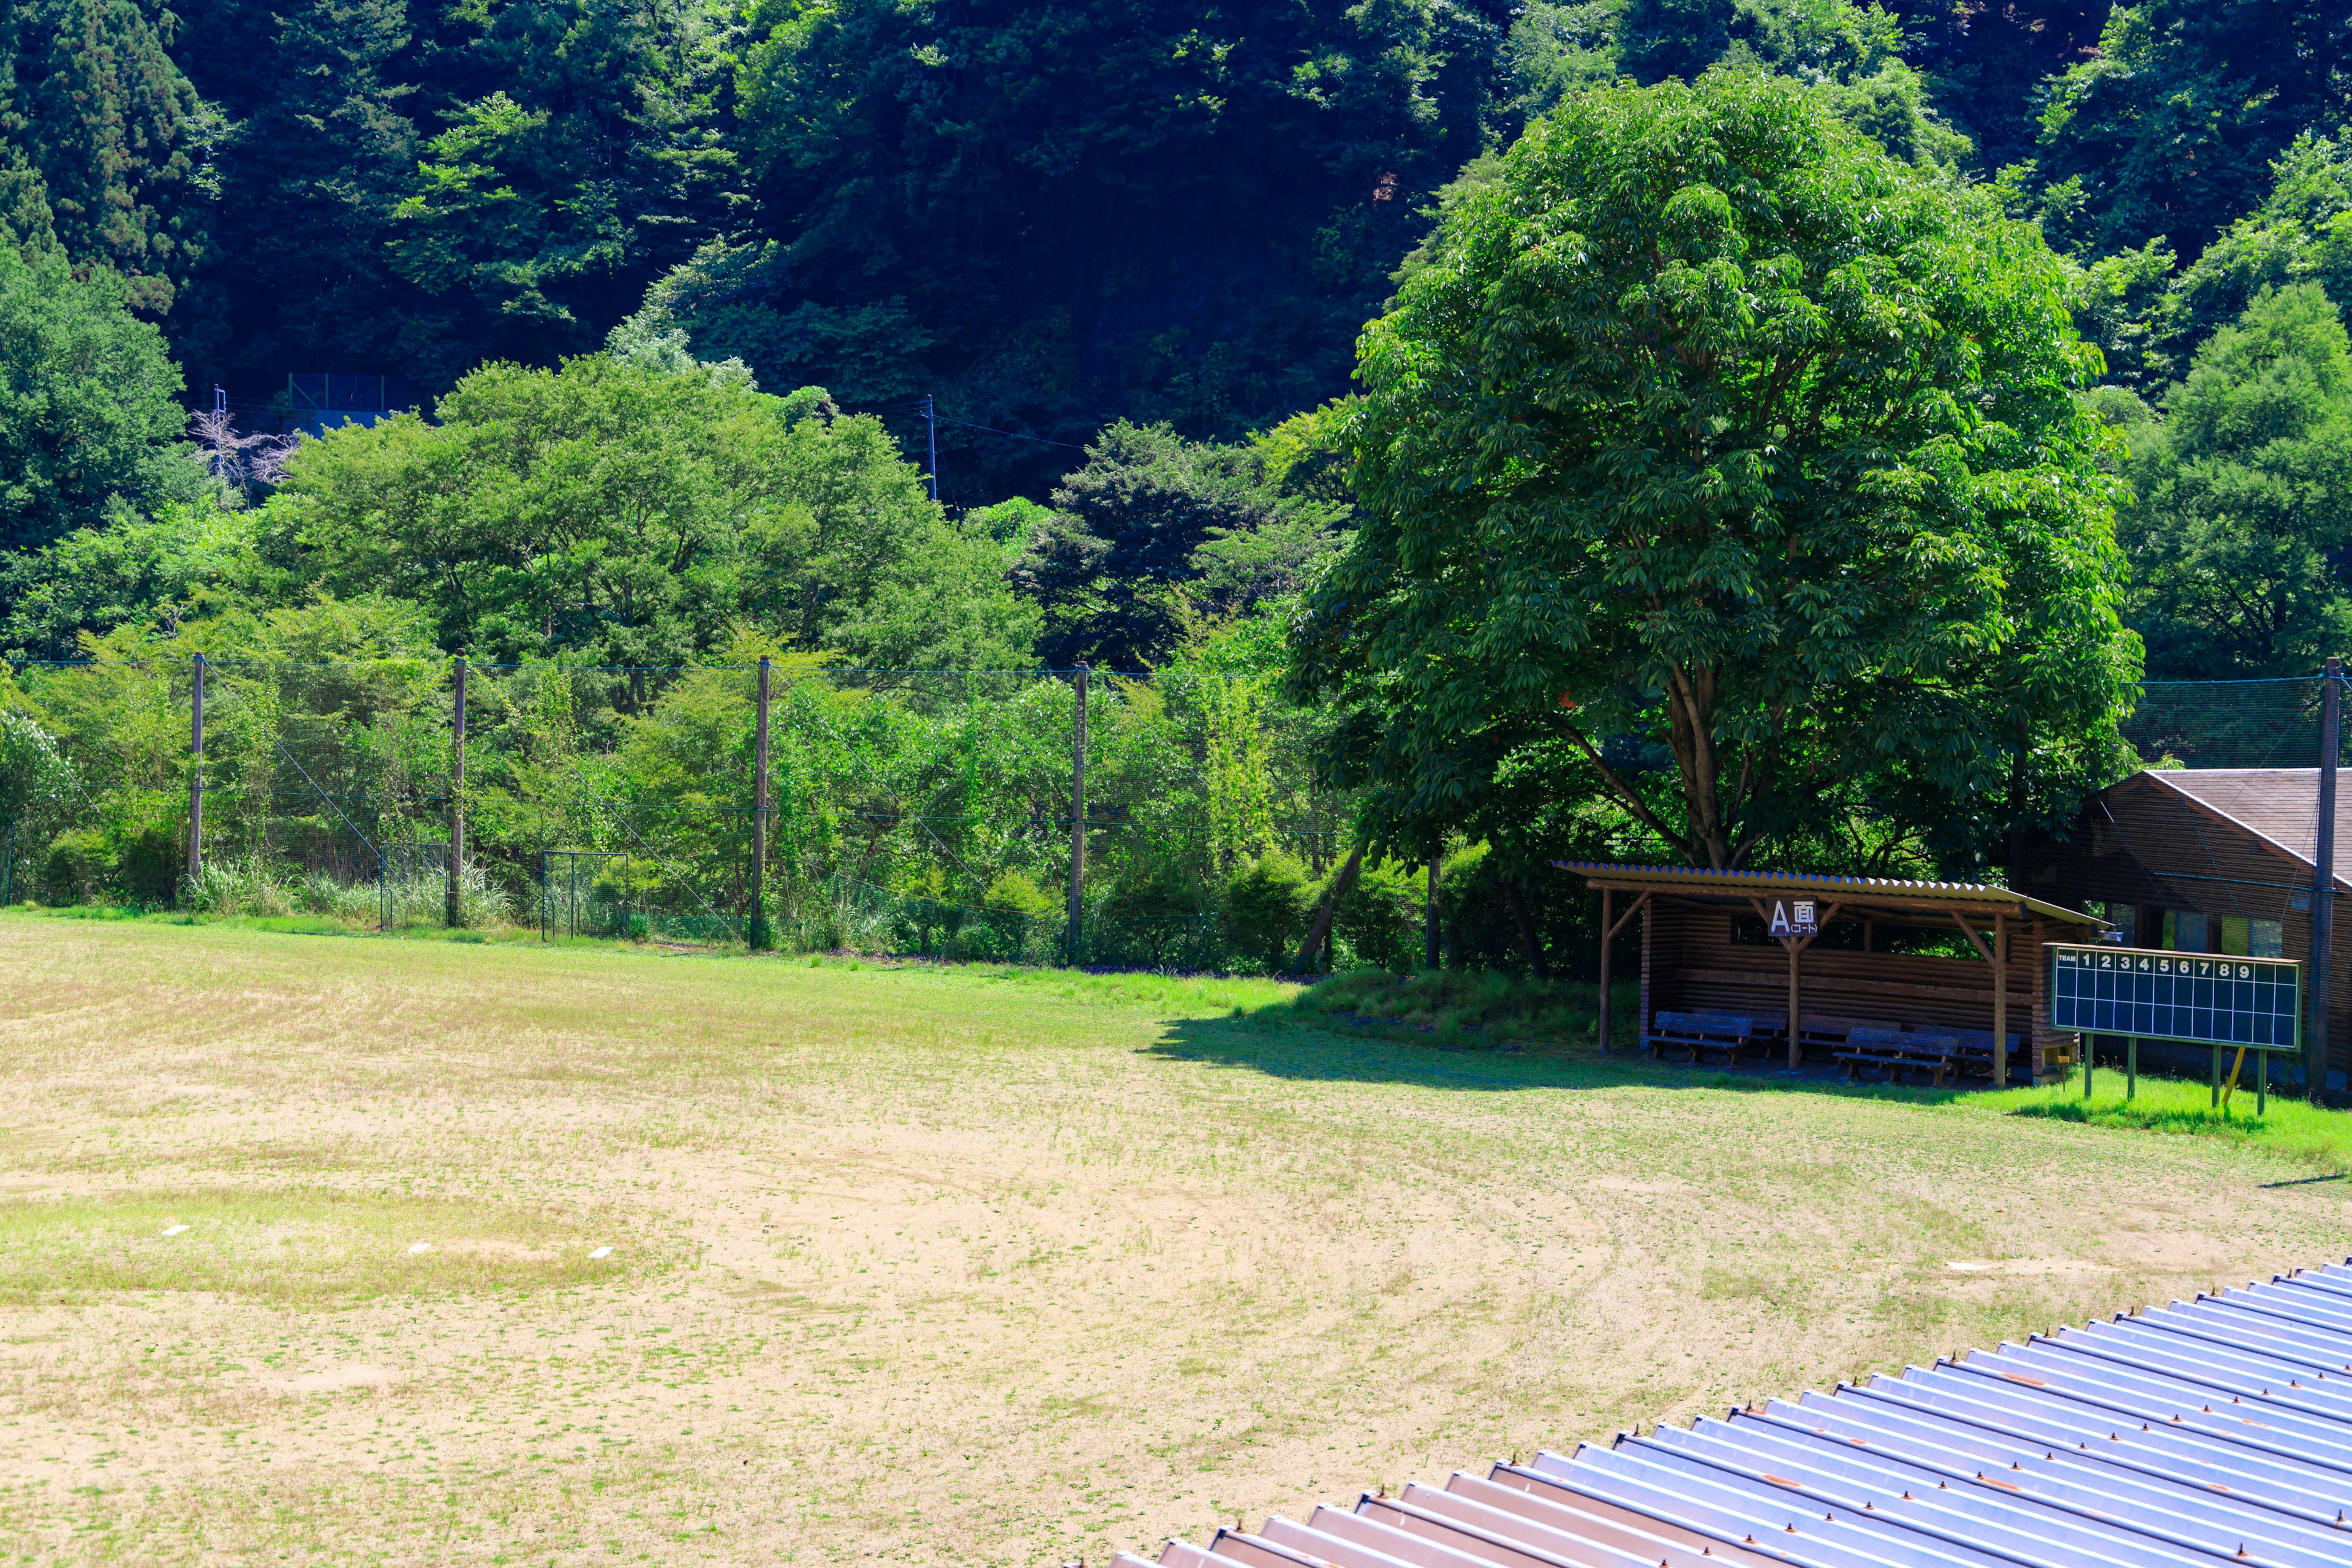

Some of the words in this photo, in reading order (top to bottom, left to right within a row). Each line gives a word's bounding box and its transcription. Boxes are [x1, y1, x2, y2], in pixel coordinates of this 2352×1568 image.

[1791, 923, 1817, 933] (コート)
[2083, 954, 2090, 966] 1
[2101, 956, 2111, 967] 2
[2120, 957, 2130, 969] 3
[2139, 959, 2149, 971] 4
[2160, 960, 2169, 972] 5
[2179, 961, 2189, 973] 6
[2200, 962, 2209, 974] 7
[2220, 964, 2230, 976] 8
[2239, 966, 2249, 978] 9
